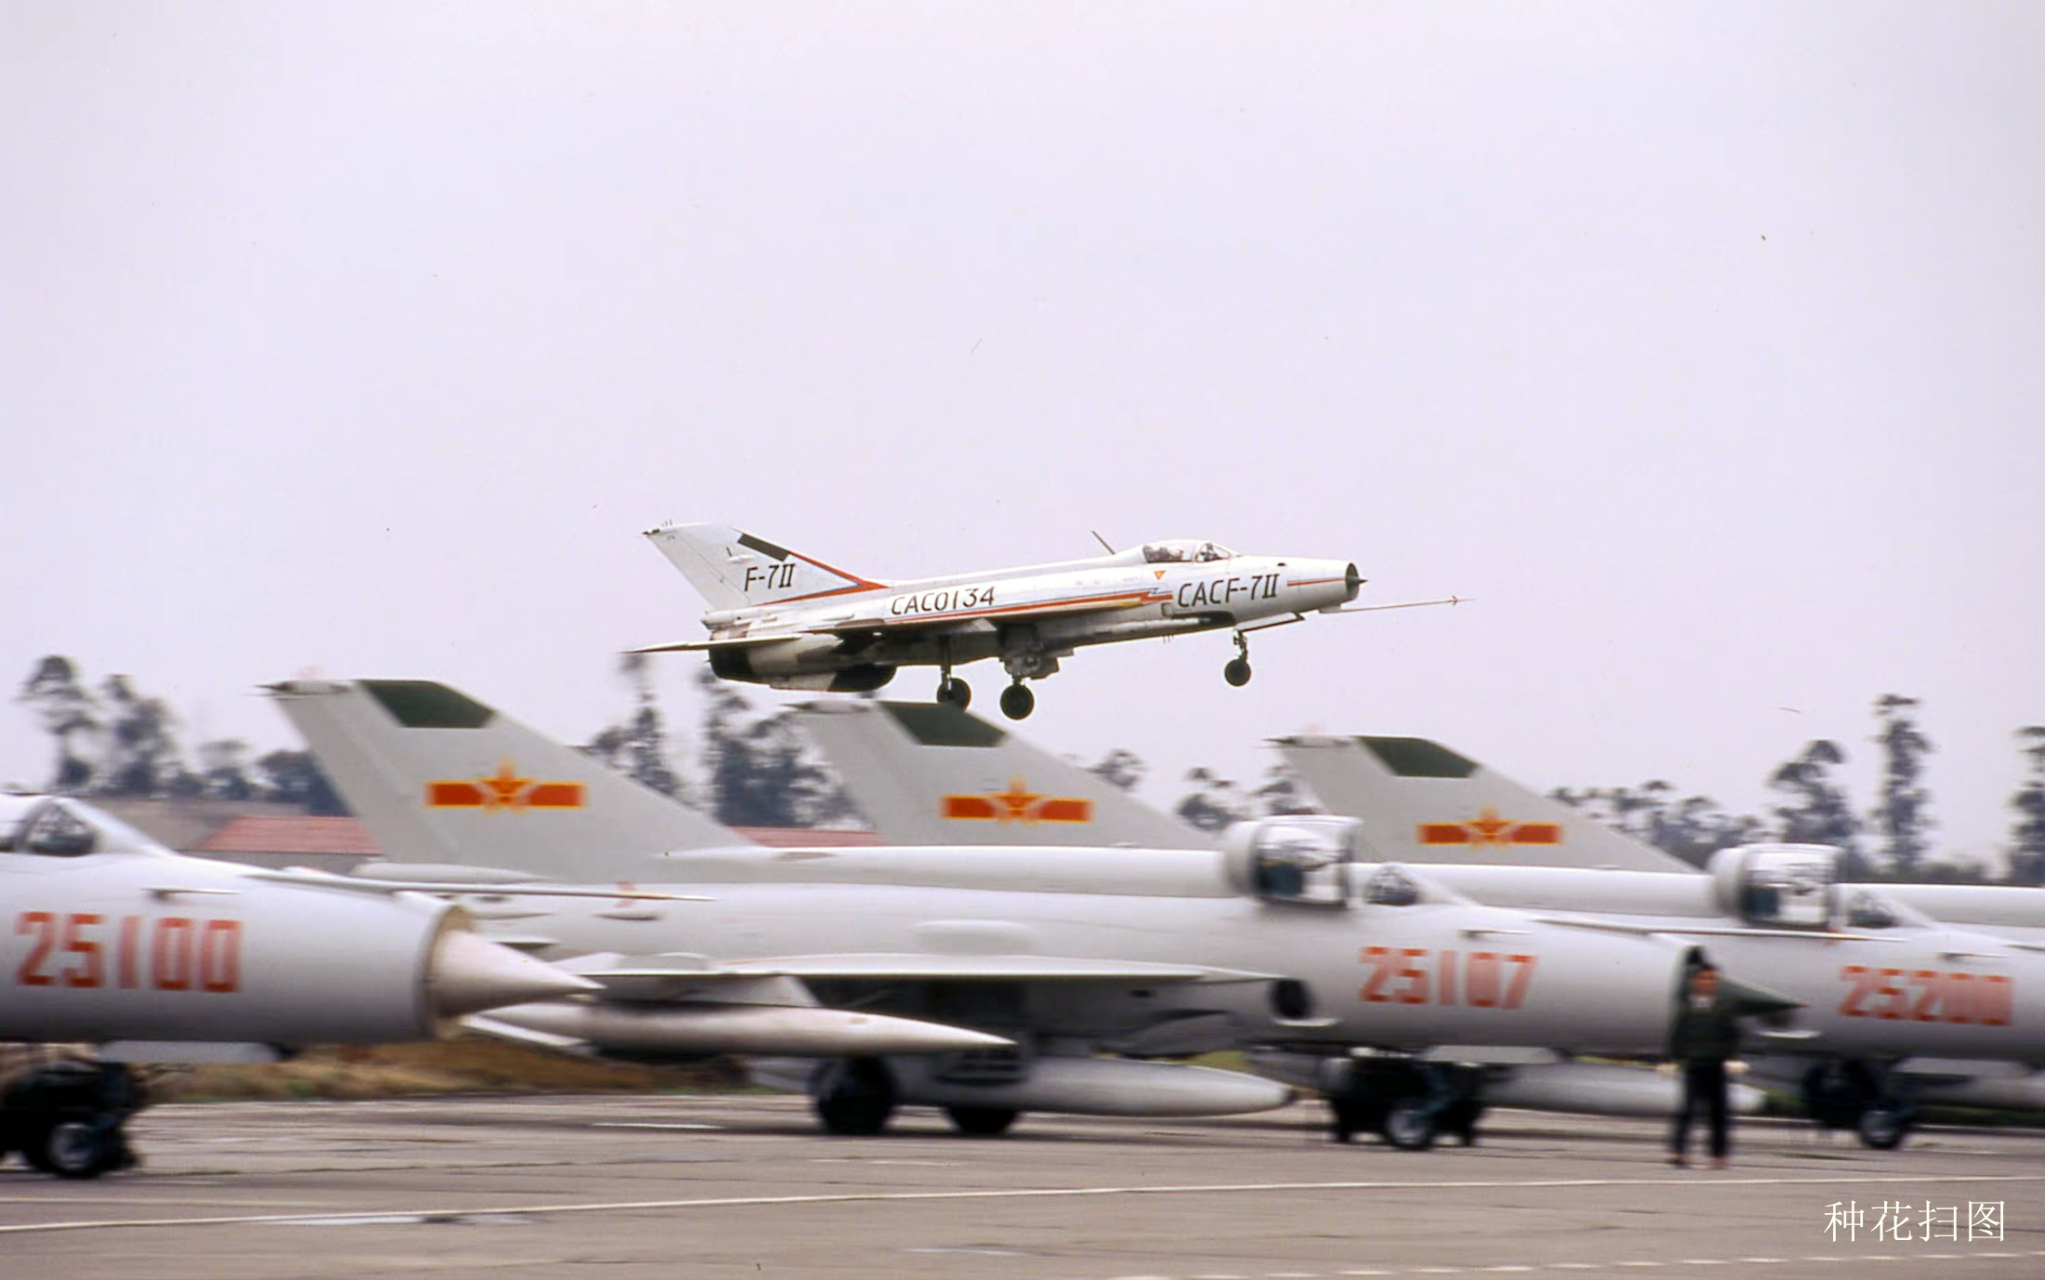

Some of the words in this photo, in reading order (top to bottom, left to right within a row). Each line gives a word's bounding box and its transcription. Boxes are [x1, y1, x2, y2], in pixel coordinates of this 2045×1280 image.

[15, 911, 245, 993] 25100
[1358, 946, 1539, 1010] 25107
[1837, 965, 2014, 1027] 25200
